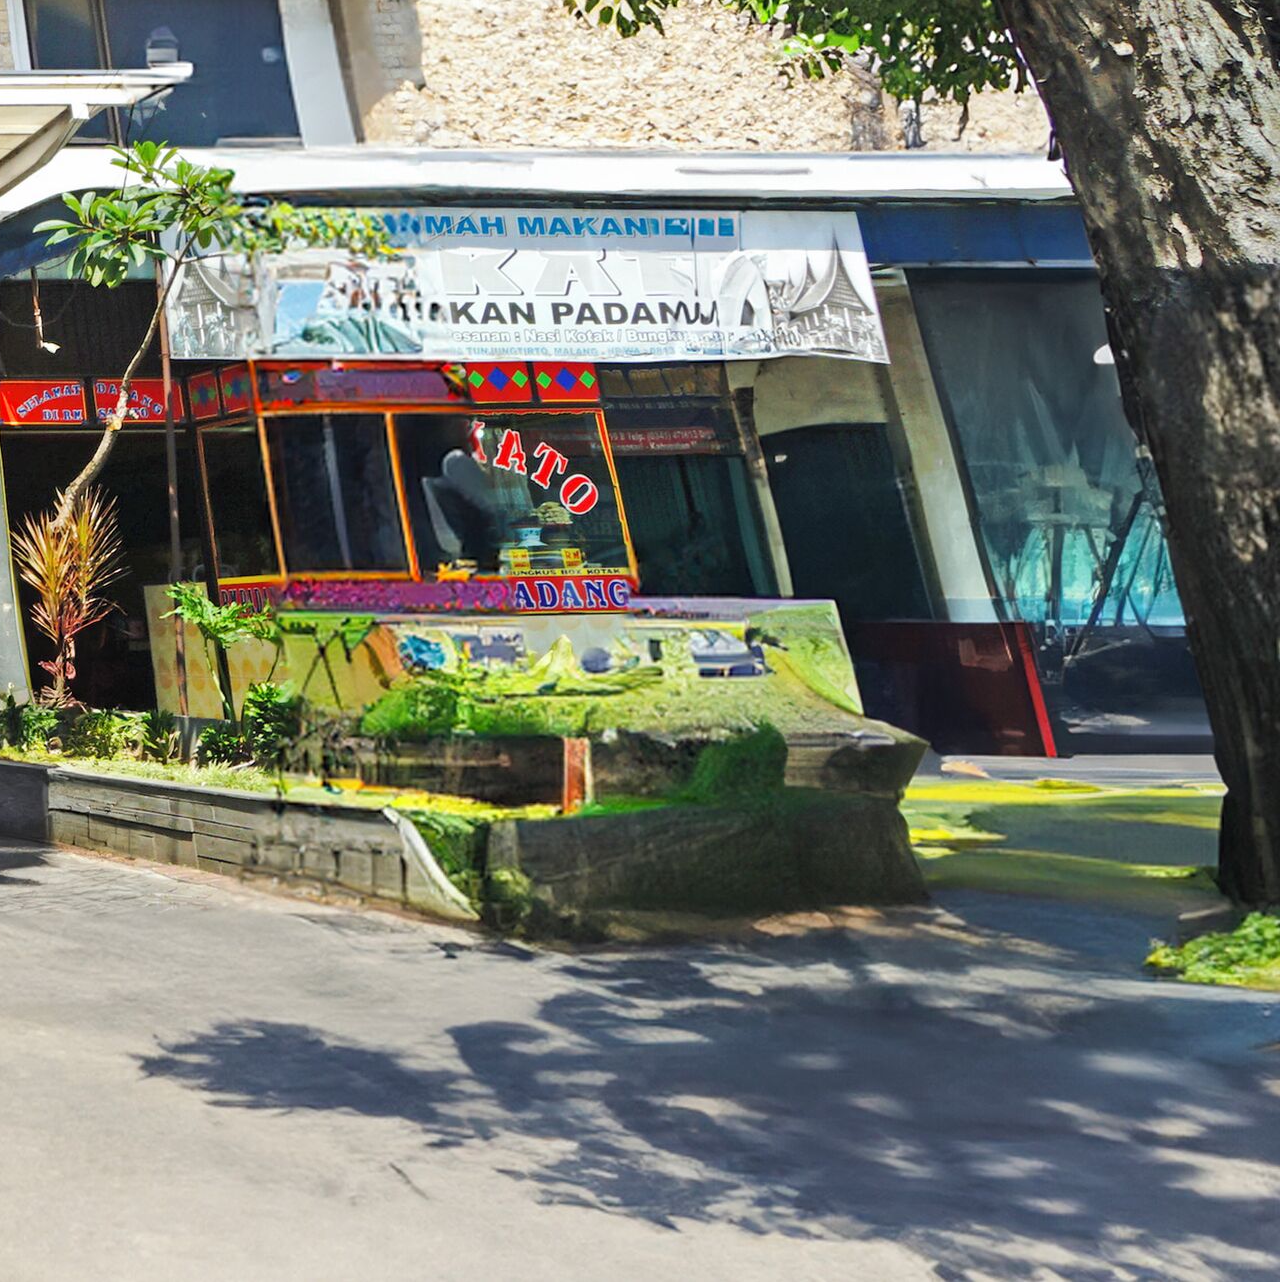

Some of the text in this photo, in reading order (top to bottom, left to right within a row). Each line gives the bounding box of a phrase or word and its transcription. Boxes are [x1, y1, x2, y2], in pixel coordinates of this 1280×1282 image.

[450, 329, 512, 343] esanan
[523, 329, 561, 343] Nasi
[565, 328, 614, 343] Kotak
[16, 382, 163, 418] SELAMAT DAANG
[42, 409, 59, 420] DI
